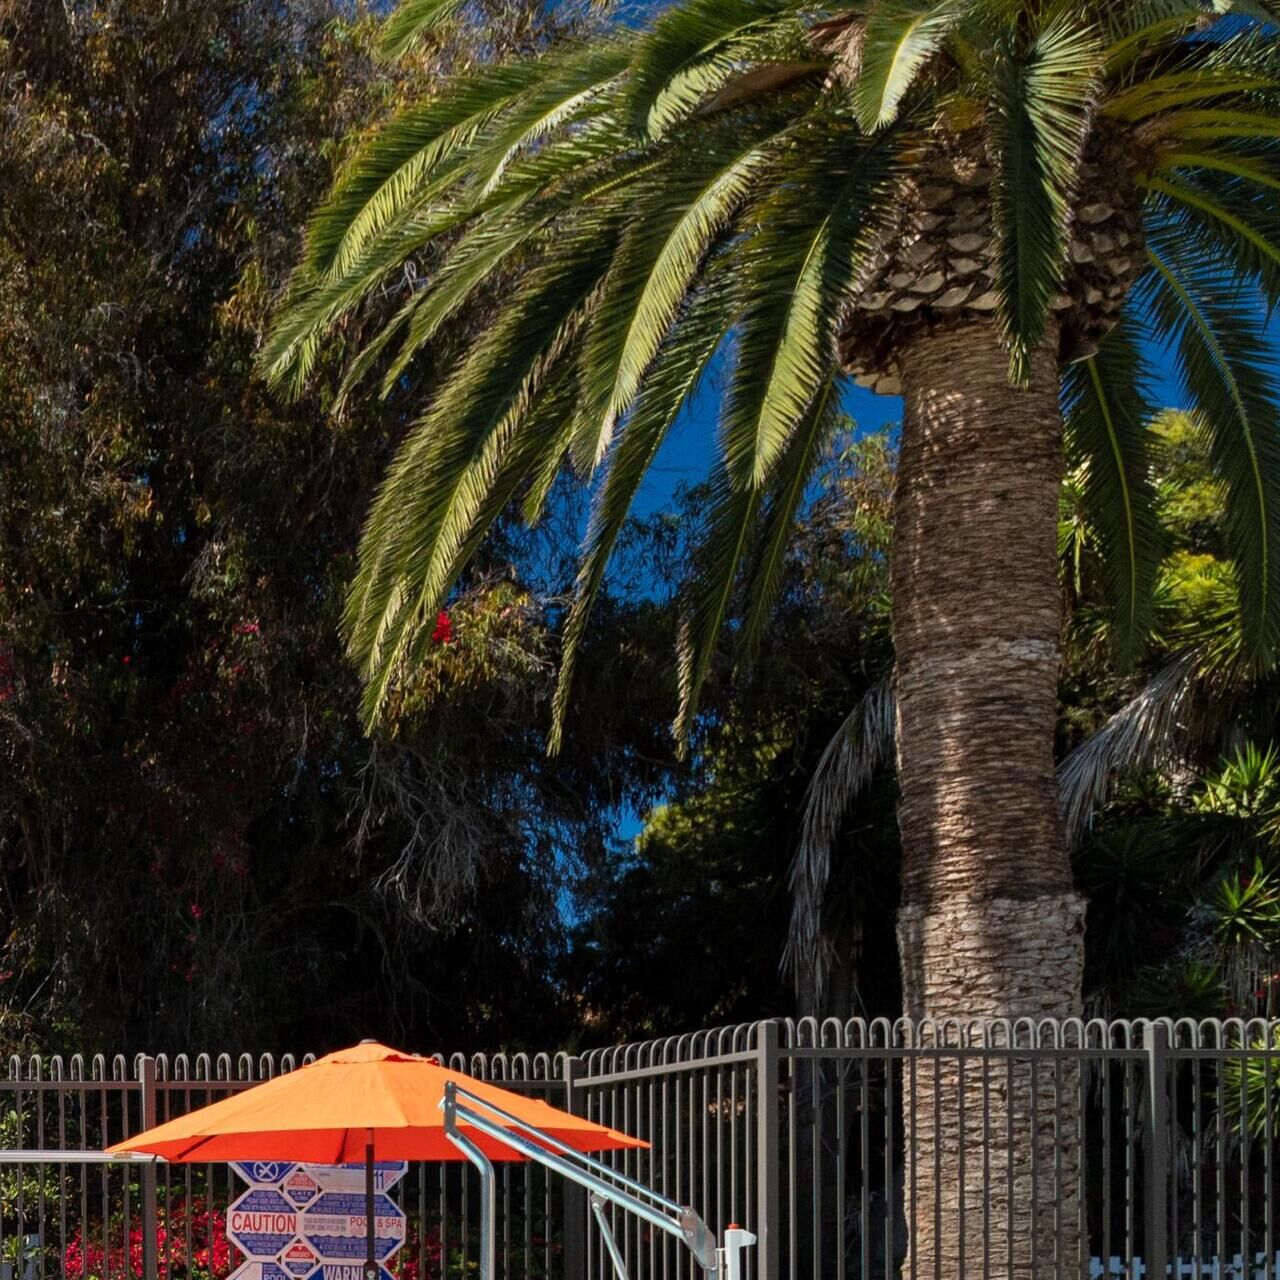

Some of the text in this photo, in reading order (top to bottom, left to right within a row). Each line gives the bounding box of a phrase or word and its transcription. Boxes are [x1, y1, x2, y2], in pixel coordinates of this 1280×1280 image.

[231, 1213, 296, 1233] CAUTION
[350, 1216, 368, 1227] POO
[377, 1218, 383, 1228] &
[385, 1218, 402, 1228] SPA
